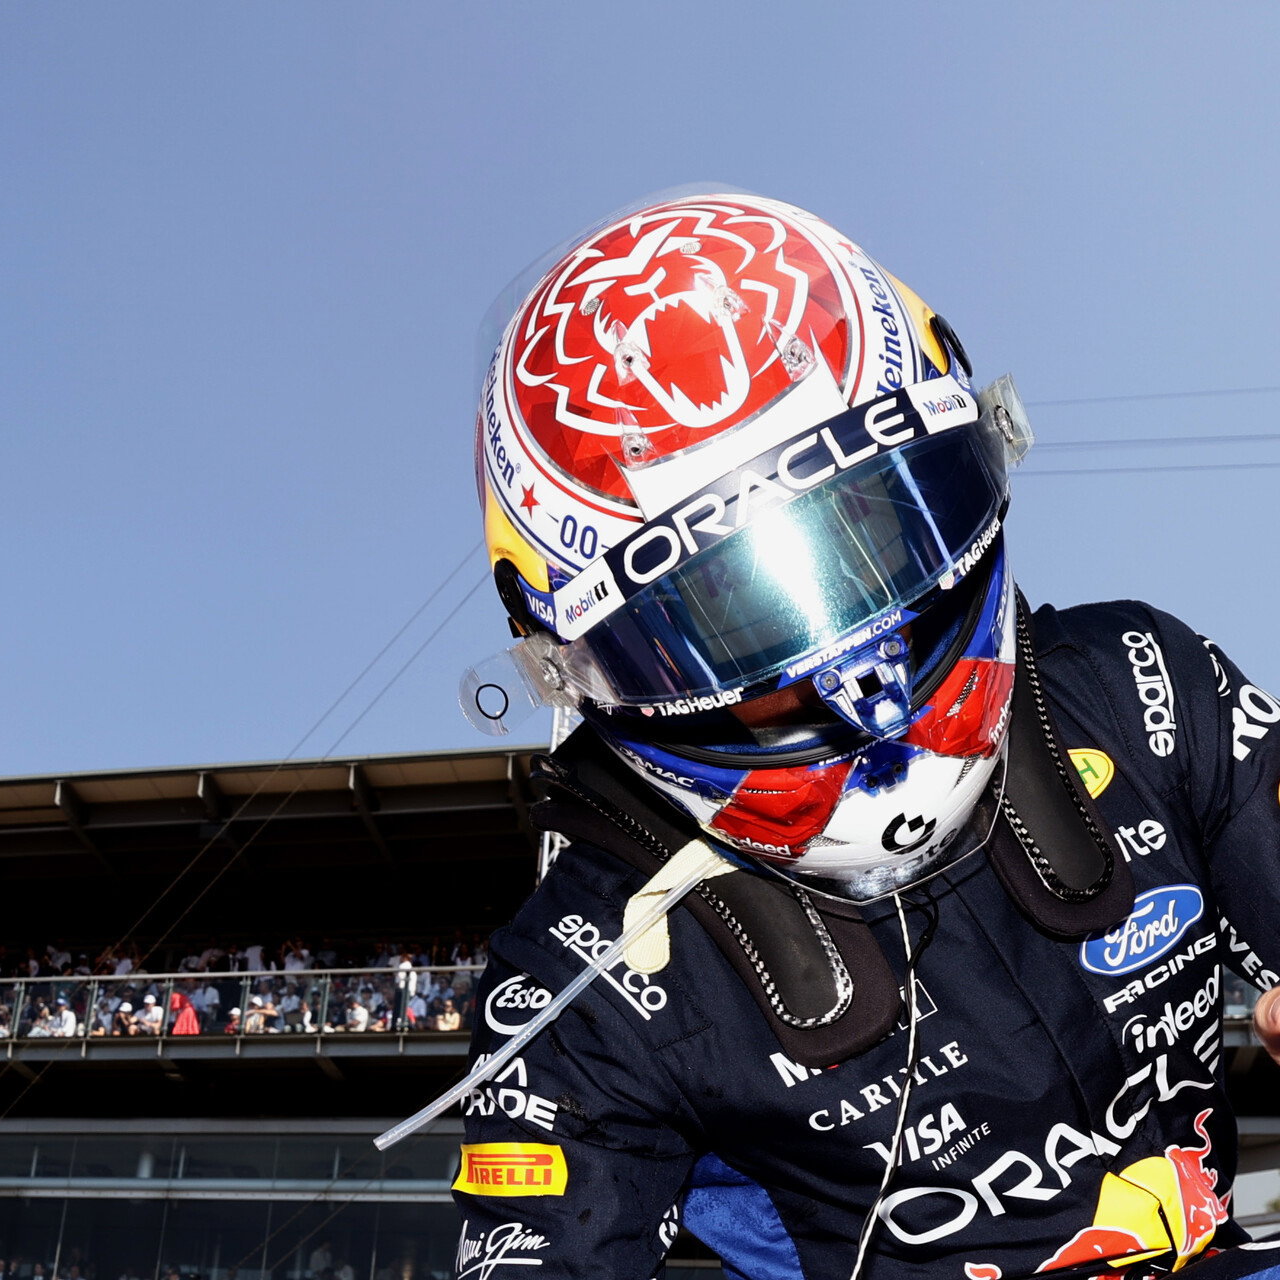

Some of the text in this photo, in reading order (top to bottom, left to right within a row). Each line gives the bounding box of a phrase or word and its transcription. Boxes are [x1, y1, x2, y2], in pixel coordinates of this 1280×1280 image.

[623, 397, 915, 585] ORACLE
[559, 514, 598, 560] 0.0
[526, 593, 557, 626] VISA
[564, 590, 597, 626] Mobil
[785, 611, 904, 680] VERSTAPPEN.COM
[1121, 630, 1177, 758] sparco
[1103, 899, 1179, 968] Ford
[1102, 932, 1218, 1014] RACING
[862, 1102, 968, 1169] VISA
[877, 1018, 1221, 1246] ORACLE
[931, 1121, 992, 1172] INFINITE
[466, 1153, 554, 1186] PIRELLI
